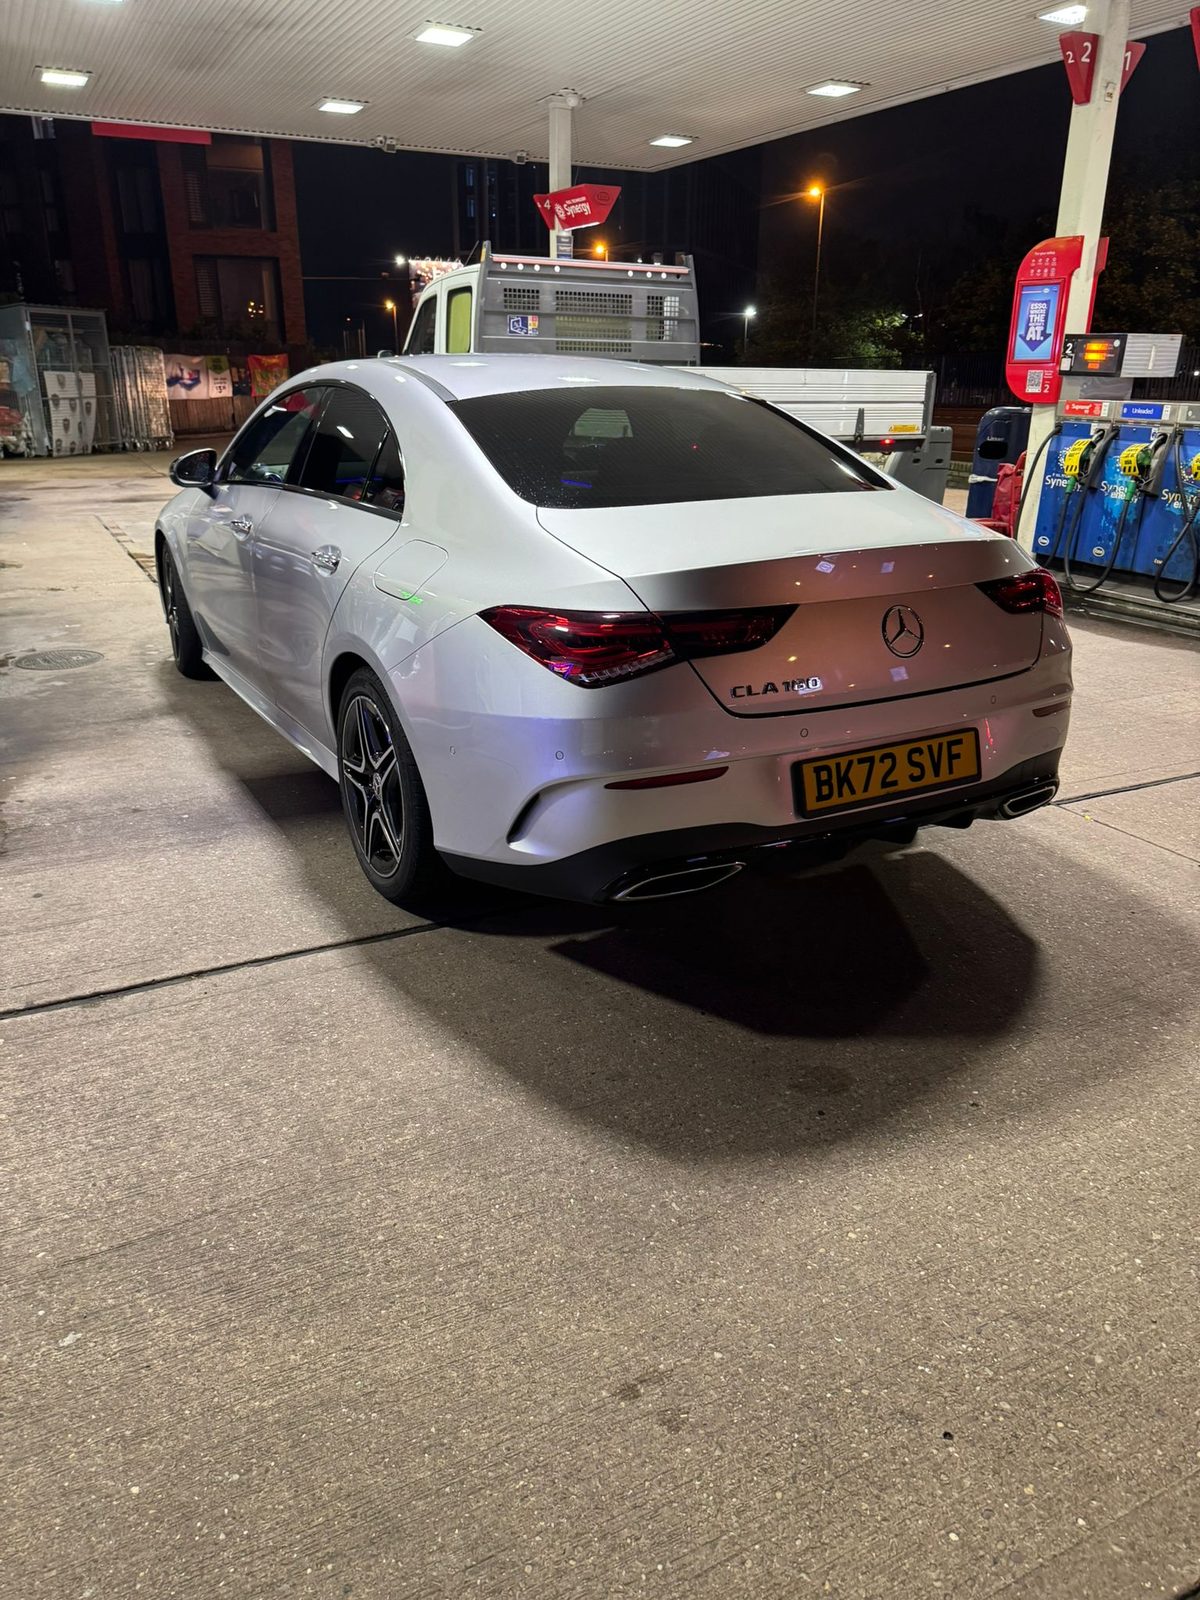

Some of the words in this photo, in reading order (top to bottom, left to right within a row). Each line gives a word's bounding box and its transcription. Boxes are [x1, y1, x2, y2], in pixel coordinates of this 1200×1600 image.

[1065, 51, 1075, 64] 2
[1081, 41, 1092, 63] 2
[1124, 50, 1132, 71] 1
[544, 199, 551, 210] 4
[563, 202, 591, 218] Synergy
[1029, 314, 1045, 322] THE
[1026, 326, 1044, 341] AT.
[1065, 342, 1073, 354] 2
[1043, 385, 1050, 393] 2
[1132, 407, 1154, 415] Unleaded
[730, 682, 779, 698] CLA
[812, 752, 898, 803] BK72
[907, 738, 965, 783] SVF
